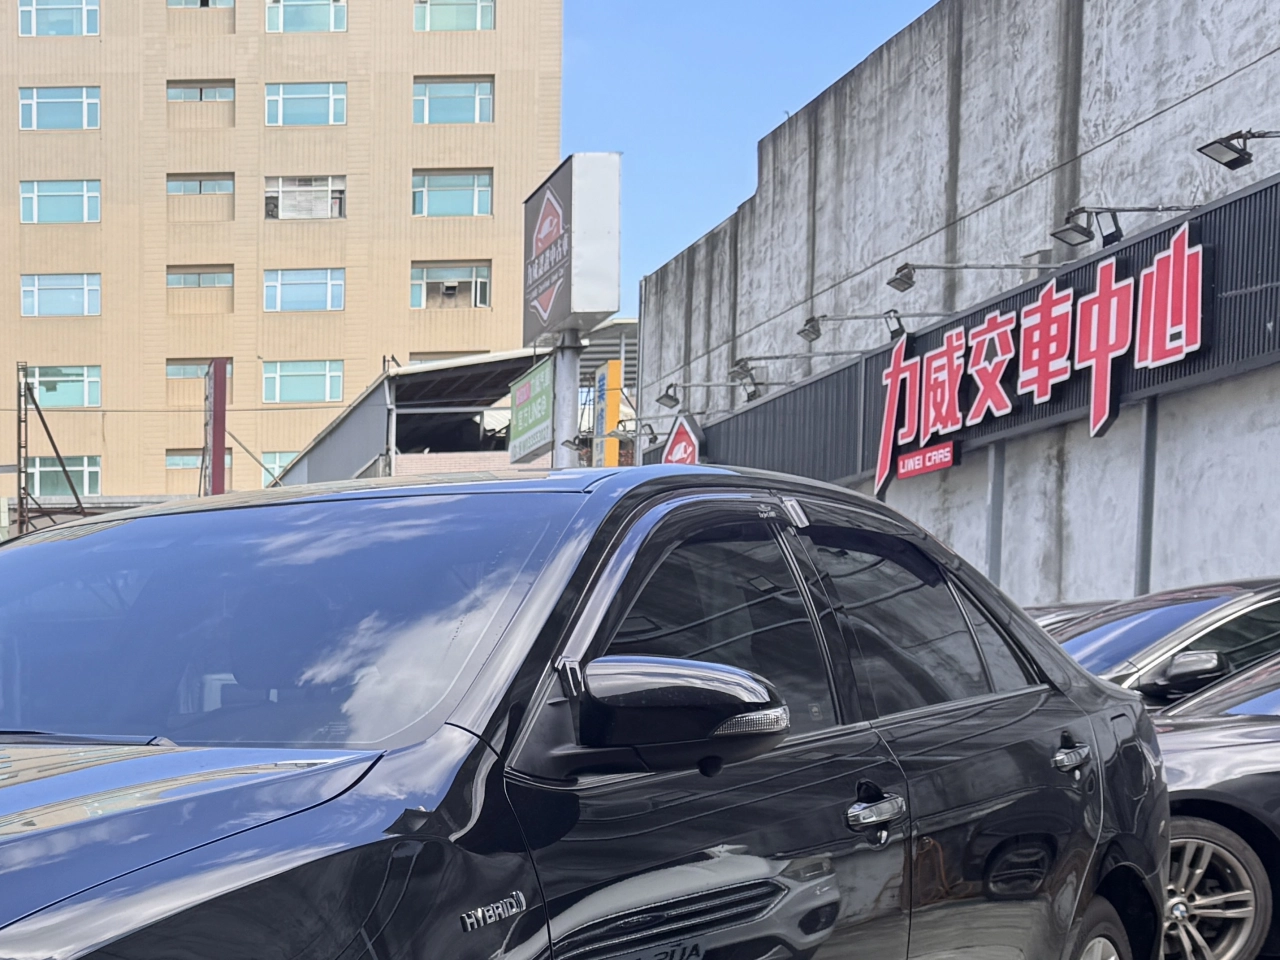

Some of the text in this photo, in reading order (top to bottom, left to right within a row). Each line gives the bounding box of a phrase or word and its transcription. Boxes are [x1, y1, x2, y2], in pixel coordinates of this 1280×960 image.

[875, 220, 1205, 496] 力威交車中心
[899, 447, 951, 474] LIWEI CARS
[460, 892, 521, 933] HYBRID
